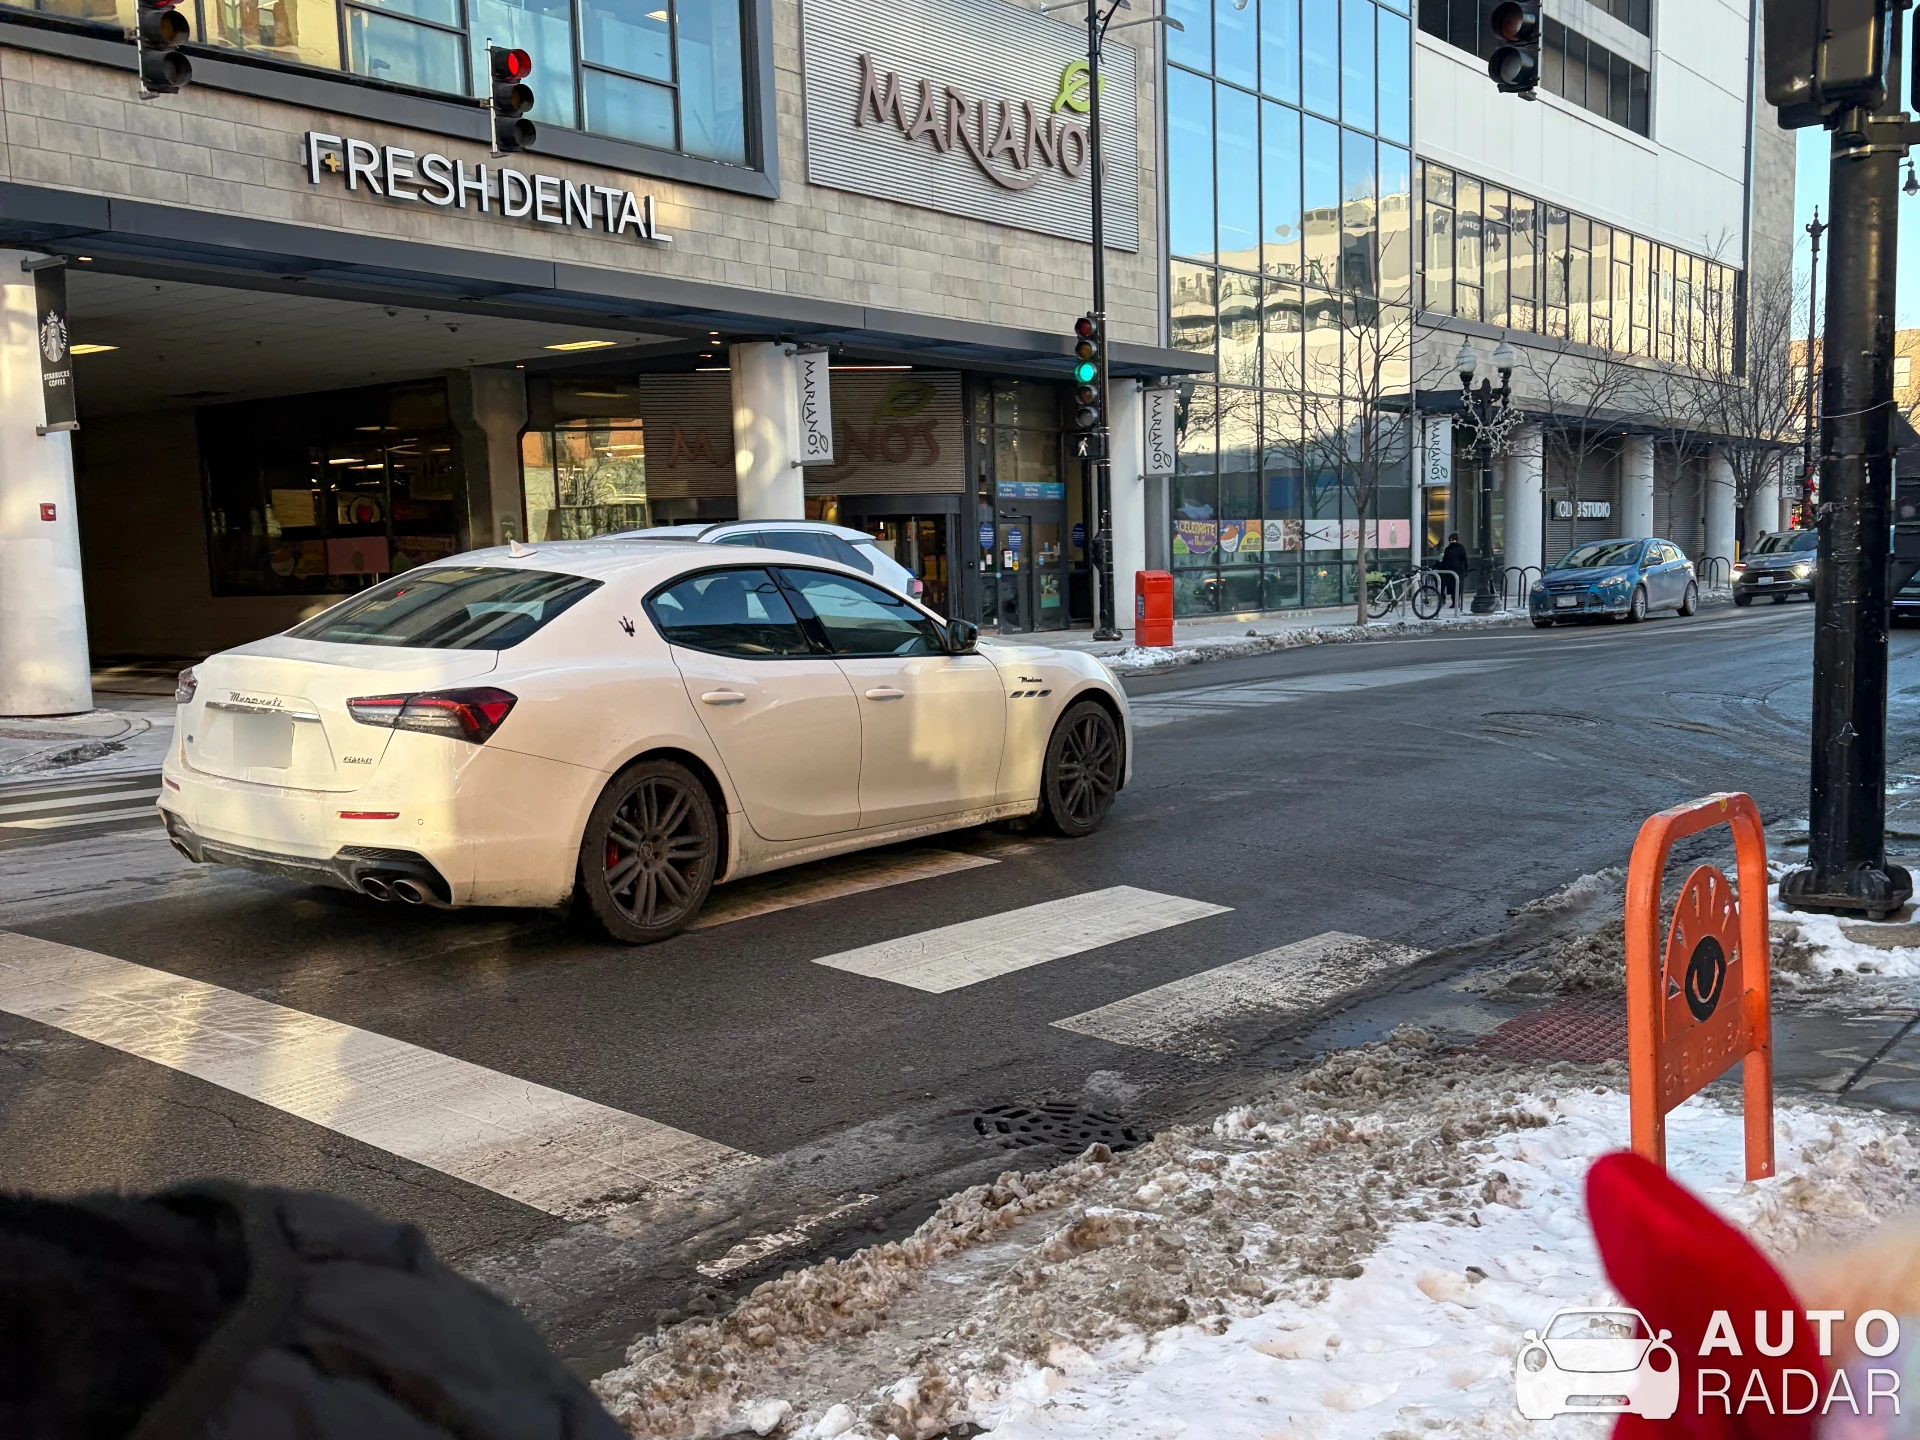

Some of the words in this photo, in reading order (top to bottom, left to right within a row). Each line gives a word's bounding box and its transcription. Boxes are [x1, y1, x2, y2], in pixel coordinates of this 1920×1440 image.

[305, 130, 489, 213] FRESH
[498, 167, 673, 243] DENTAL
[43, 369, 70, 381] STARBUCKS
[48, 378, 66, 387] COFFEE
[802, 360, 820, 455] MARIANO'S
[1148, 395, 1163, 470] MARIANO'S
[1582, 501, 1611, 518] STUDIO
[229, 691, 285, 708] Maserati
